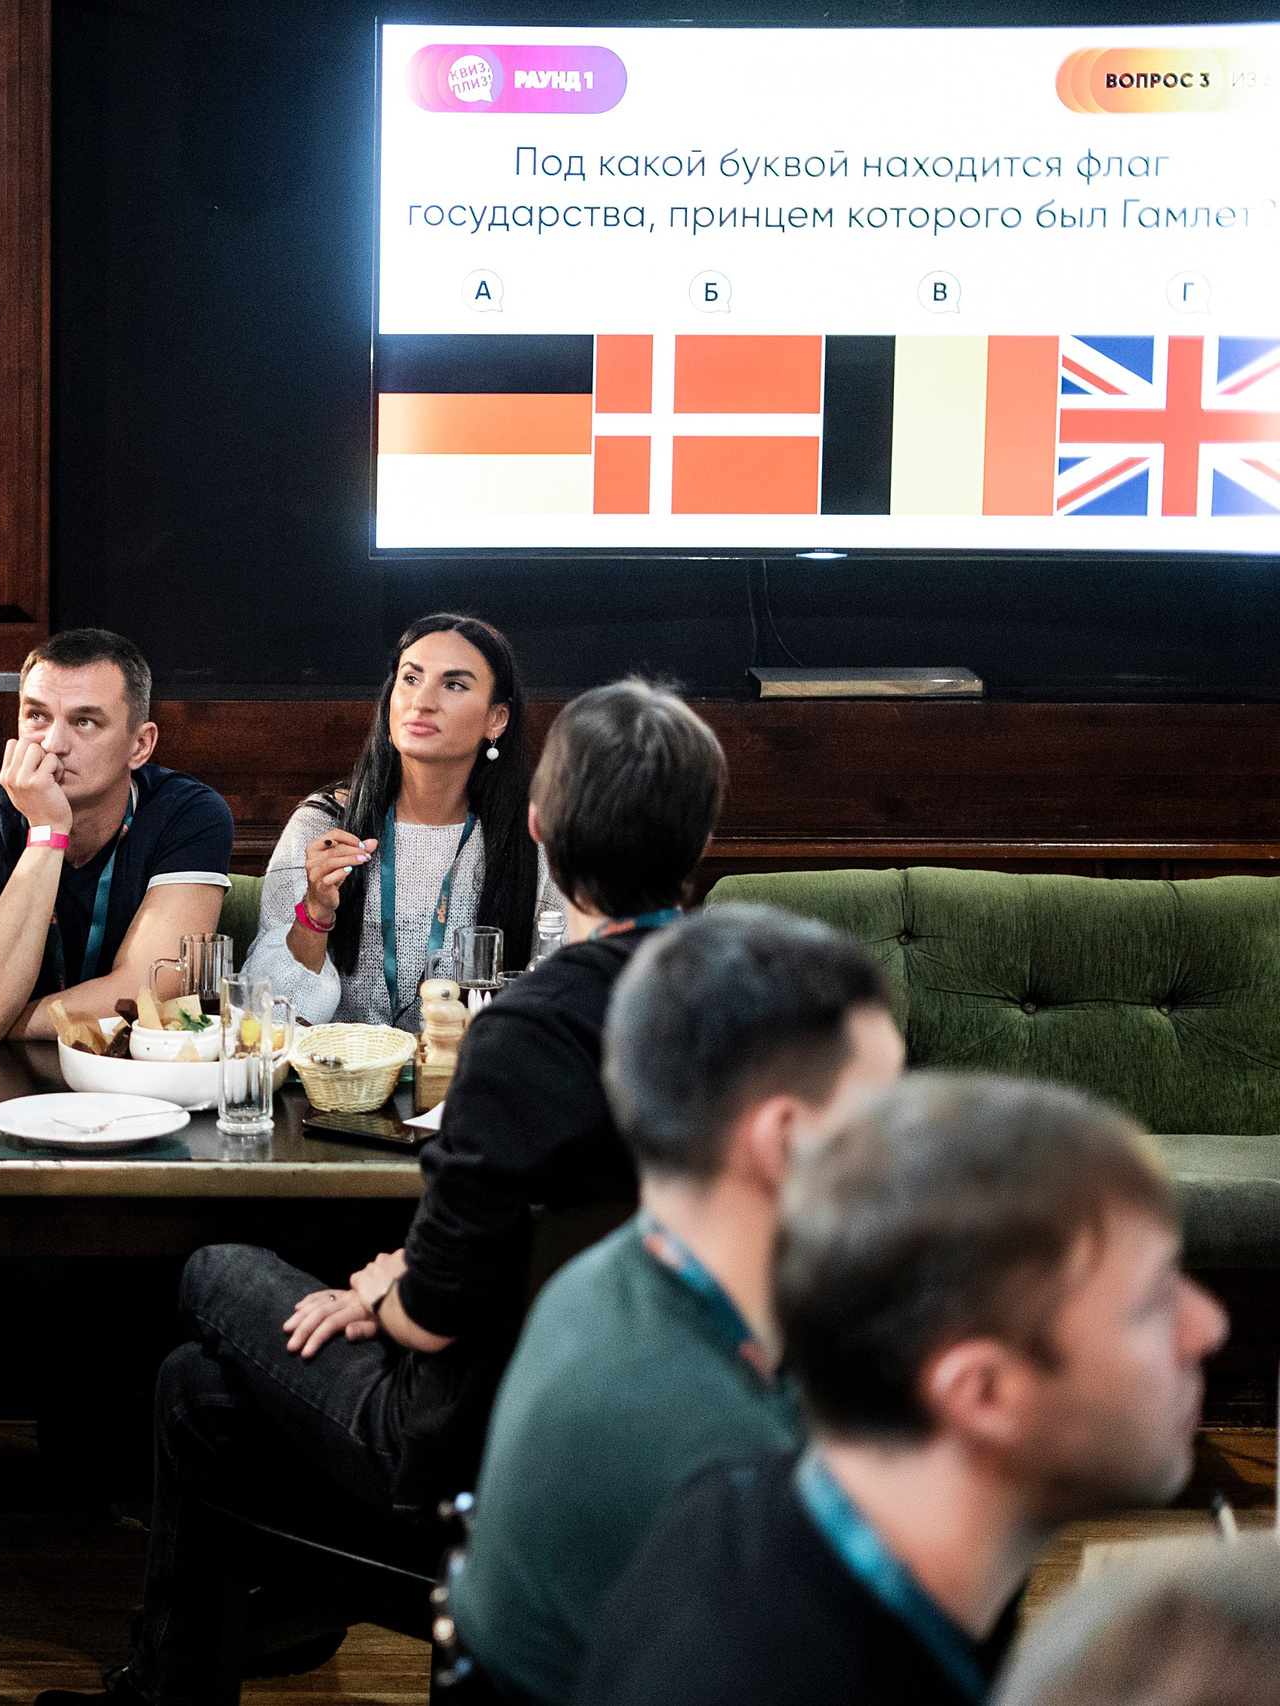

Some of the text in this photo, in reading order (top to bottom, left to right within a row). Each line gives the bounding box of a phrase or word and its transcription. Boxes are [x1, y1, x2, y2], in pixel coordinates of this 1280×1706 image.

[514, 70, 594, 92] РАУНД 1
[1105, 72, 1194, 89] ВОПРОС
[1199, 72, 1211, 89] 3
[1231, 71, 1258, 88] ИЗ
[515, 146, 1170, 186] Под какой буквой находится флаг
[408, 205, 656, 235] государства,
[669, 207, 834, 235] принцем
[848, 206, 1022, 236] которого
[1036, 199, 1108, 229] был
[474, 280, 492, 300] А
[704, 282, 719, 302] Б
[933, 282, 948, 302] В
[1183, 282, 1195, 302] Г
